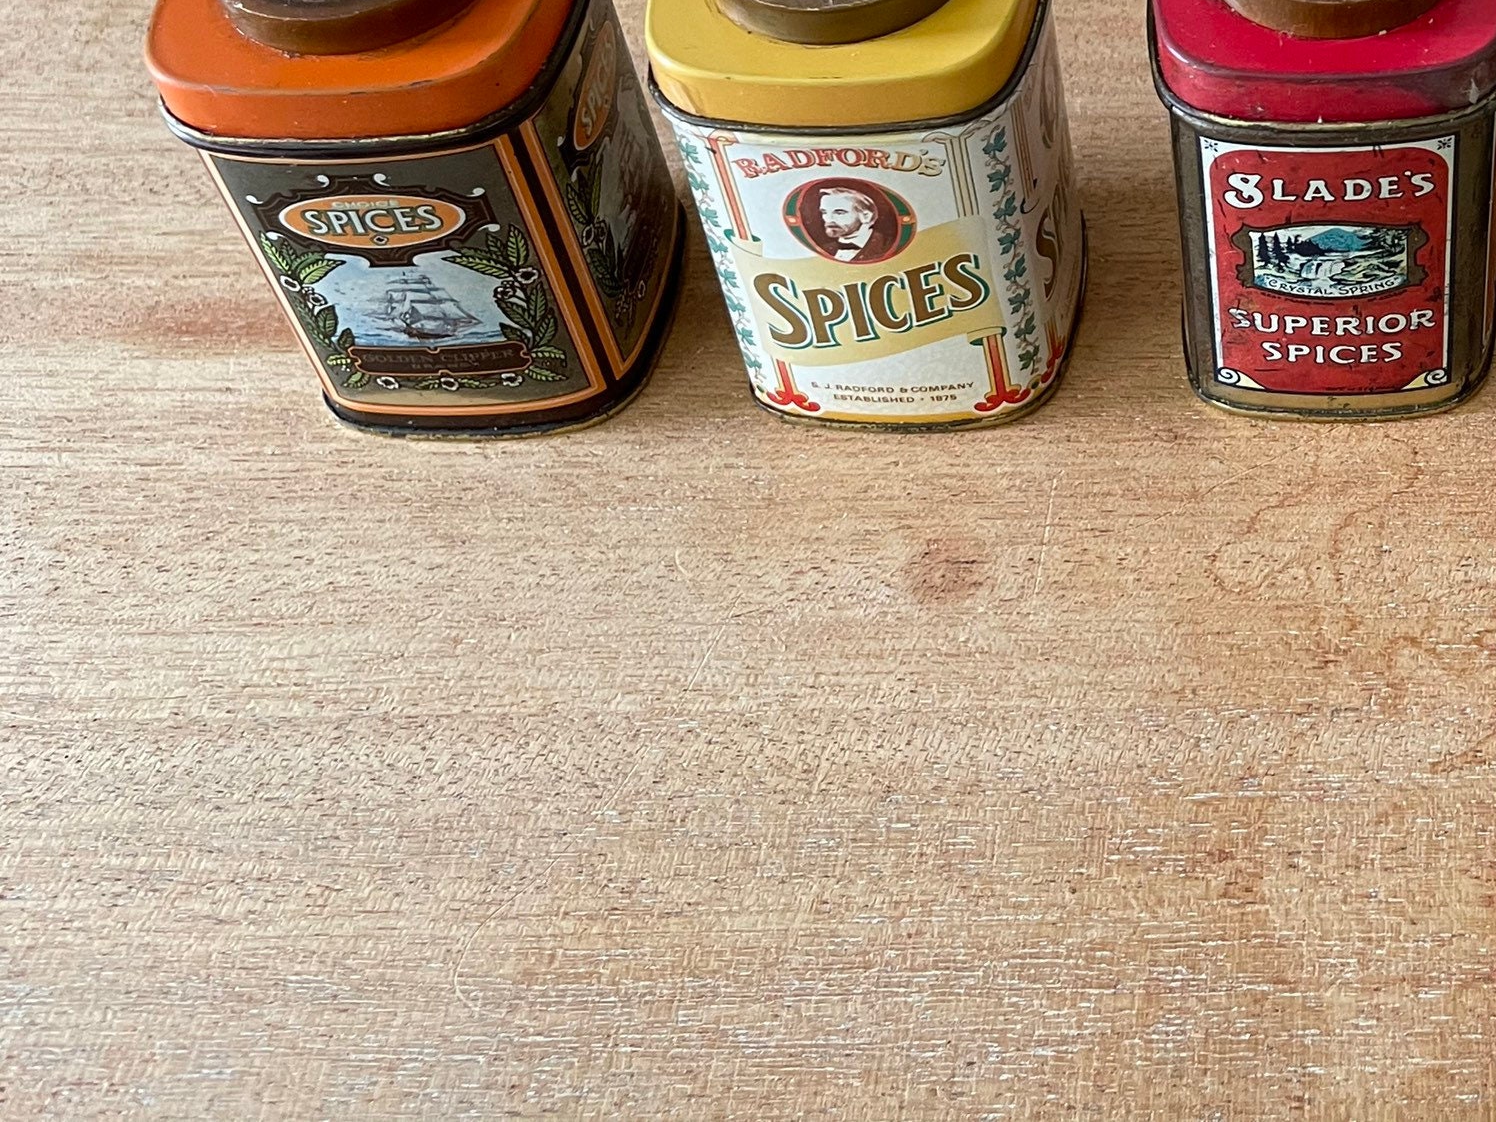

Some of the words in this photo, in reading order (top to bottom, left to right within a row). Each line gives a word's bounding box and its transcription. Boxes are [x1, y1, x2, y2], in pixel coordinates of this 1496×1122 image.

[731, 147, 947, 179] RADFORD'S
[1224, 170, 1435, 209] SLADE'S
[302, 204, 444, 236] SPICES
[753, 252, 991, 349] SPICES
[1228, 307, 1436, 337] SUPERIOR
[1261, 342, 1404, 365] SPICES
[833, 393, 915, 403] ESTABLISHED
[836, 384, 895, 394] RADFORD
[911, 381, 974, 394] COMPANY
